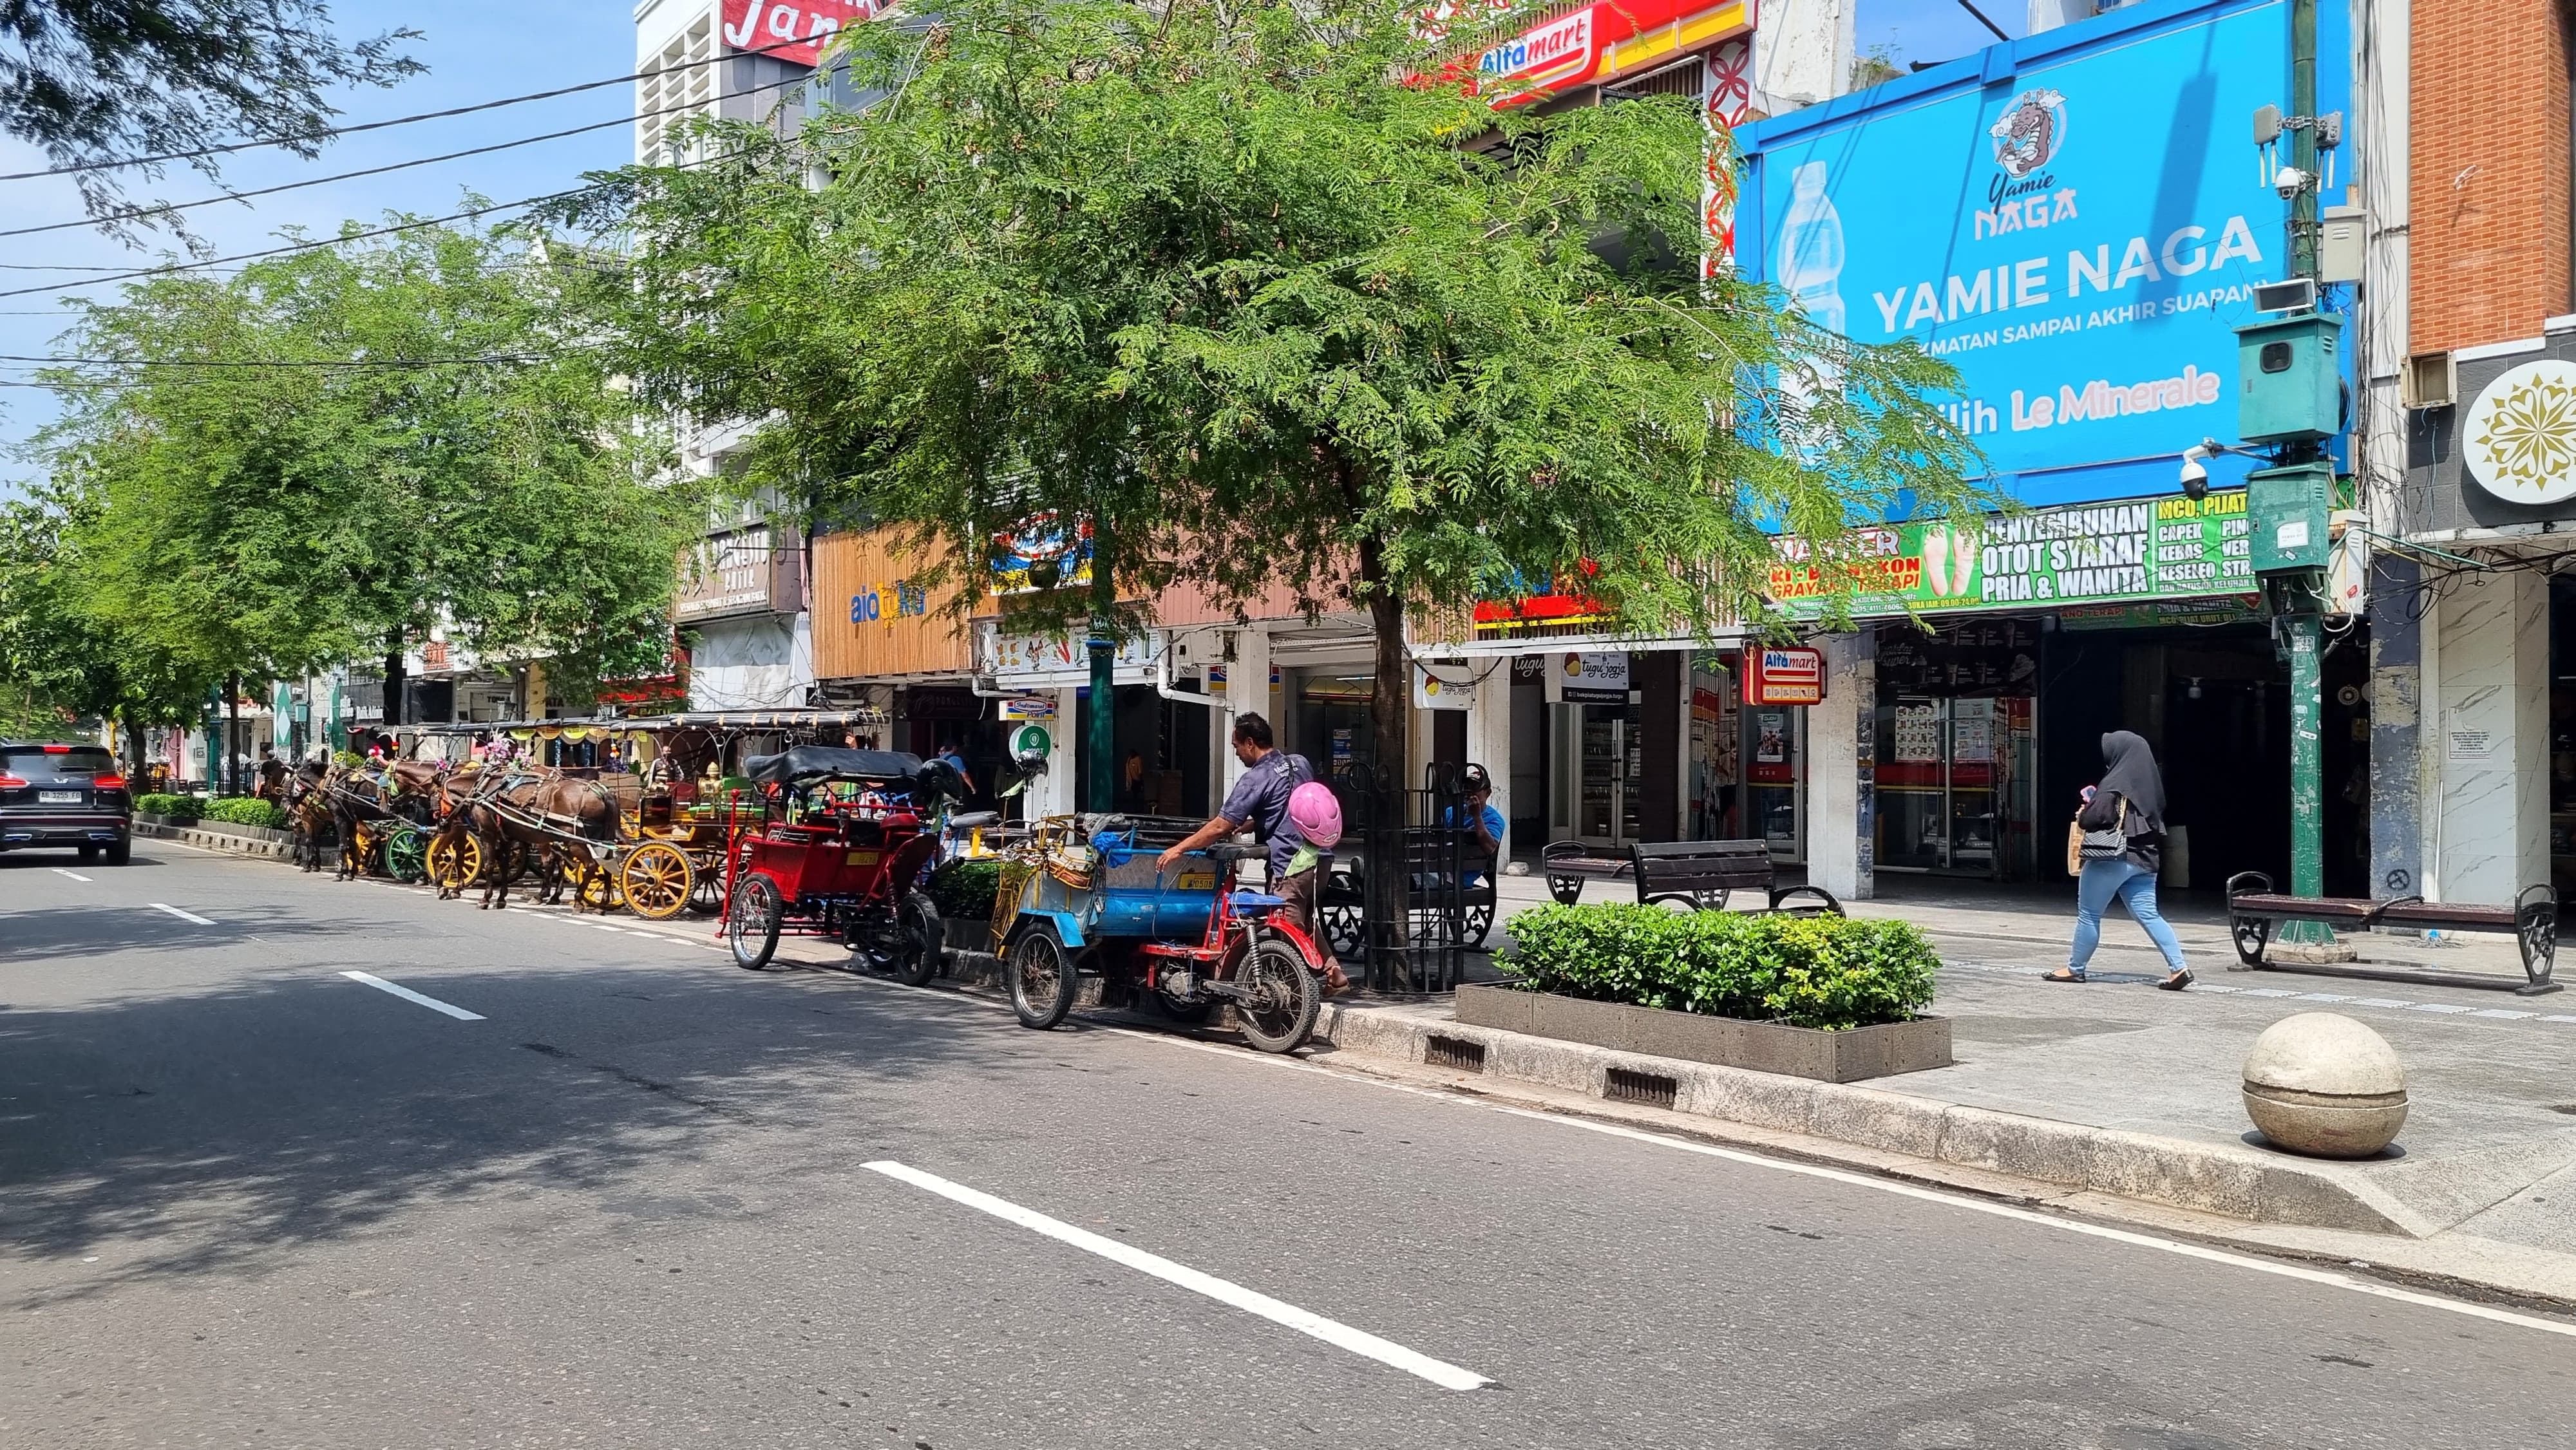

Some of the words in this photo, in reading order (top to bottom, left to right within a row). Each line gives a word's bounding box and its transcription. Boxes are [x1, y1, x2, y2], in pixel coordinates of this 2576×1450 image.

[1482, 18, 1586, 73] Alfamart
[1988, 172, 2056, 215] Yamie
[1975, 187, 2078, 241] NAGA
[1872, 256, 2049, 334] YAMIE
[2068, 215, 2263, 297] NAGA
[2002, 314, 2081, 344] SAMPAI
[2087, 299, 2157, 329] AKHIR
[2162, 279, 2268, 315] SUAPAN
[2012, 390, 2054, 431] Le
[2058, 364, 2221, 424] Minerale
[2158, 498, 2201, 520] MCO,
[2203, 493, 2248, 516] PIJAT
[1982, 502, 2148, 546] PENYEMBUHAN
[2157, 522, 2204, 543] CAPEK
[2222, 518, 2249, 537] PIN
[1981, 541, 2045, 576] OTOT
[2049, 532, 2148, 571] SYARAF
[2158, 543, 2203, 562] KEBAS
[724, 569, 755, 592] BATIK
[1981, 575, 2033, 603] PRIA
[2036, 576, 2054, 599] &
[2056, 565, 2149, 598] WANITA
[2158, 561, 2217, 582] KESELEO
[2222, 560, 2255, 578] STR
[2159, 584, 2175, 592] DAN
[2214, 578, 2249, 588] KELUHAN
[1926, 599, 1940, 608] JAM:
[1941, 596, 1980, 607] 09.00-24.00
[1582, 659, 1602, 678] tugu
[1600, 662, 1626, 679] jogja
[1765, 653, 1817, 670] Alfamart
